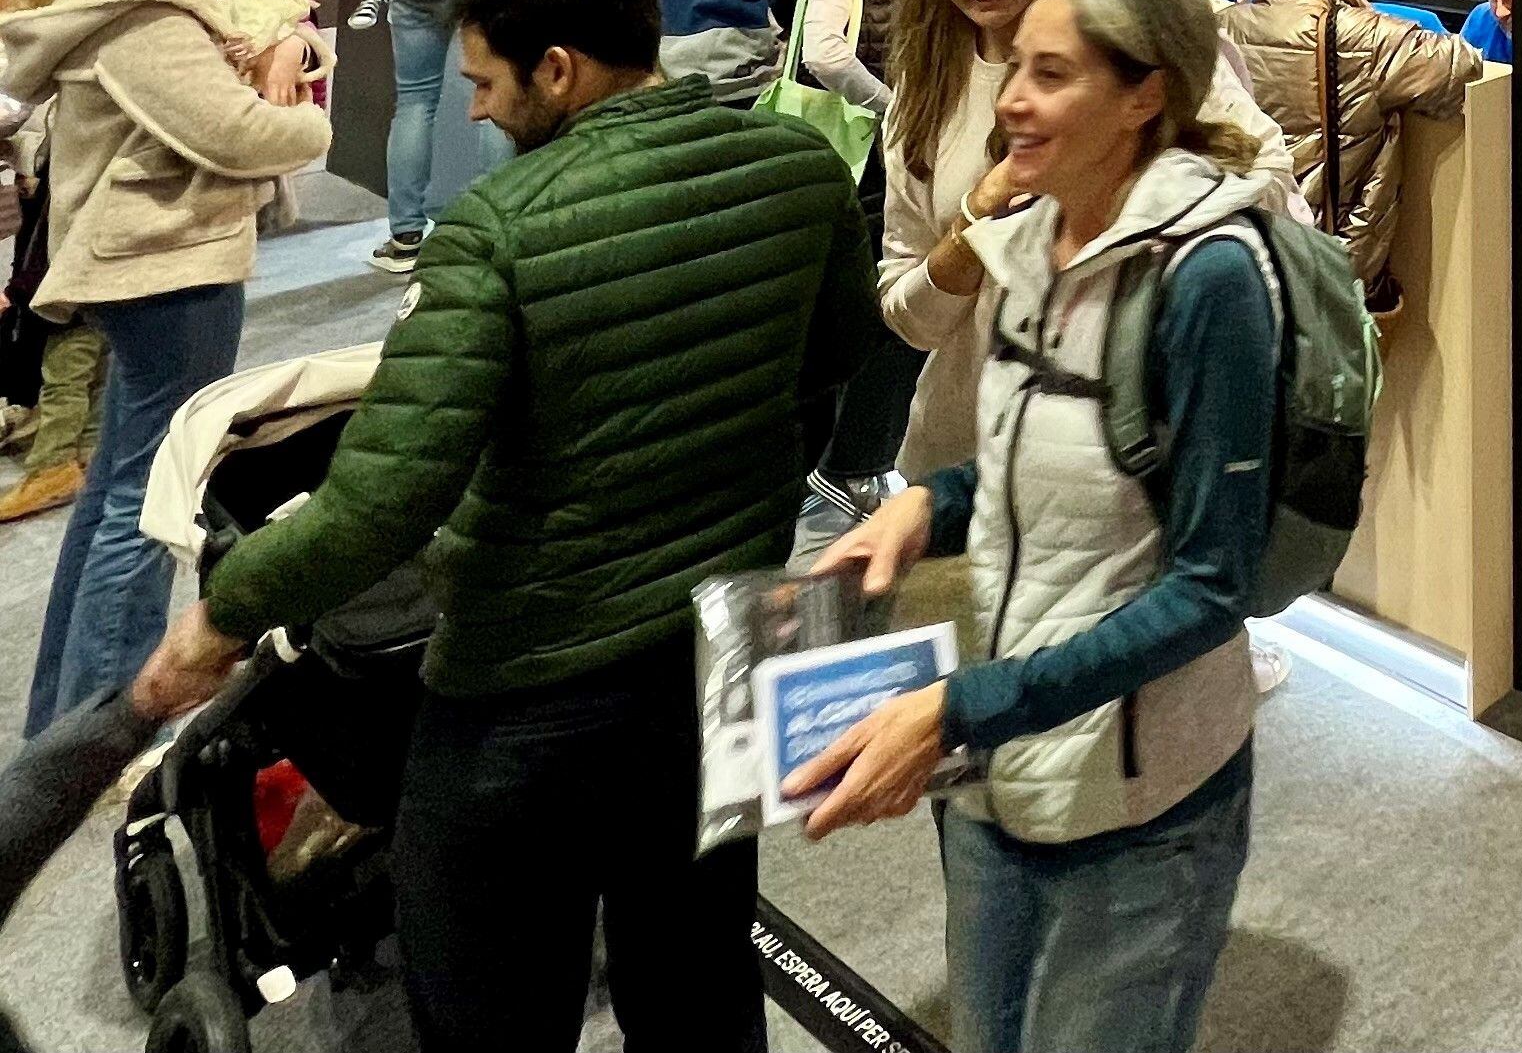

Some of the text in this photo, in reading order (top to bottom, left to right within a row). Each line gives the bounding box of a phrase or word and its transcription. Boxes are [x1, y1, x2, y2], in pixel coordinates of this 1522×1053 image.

[774, 948, 830, 999] ESPERA
[820, 991, 871, 1027] AQUÍ
[854, 1017, 891, 1049] PER
